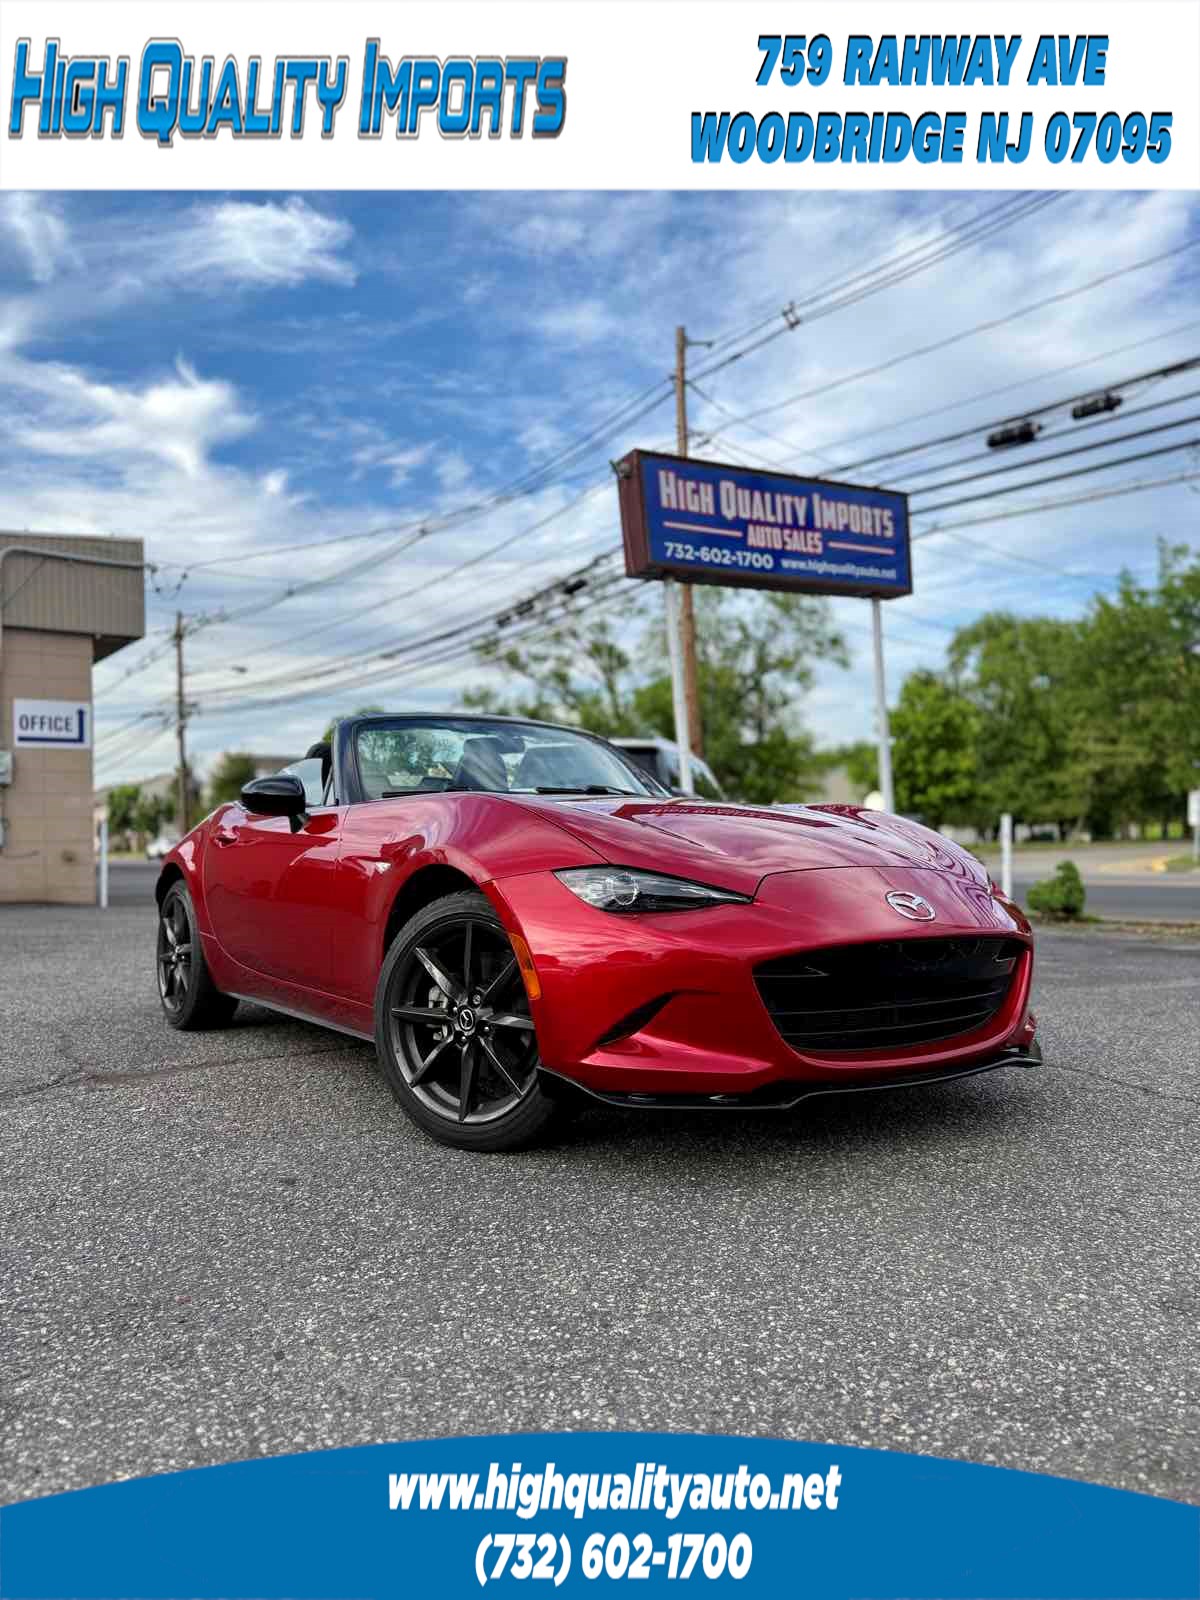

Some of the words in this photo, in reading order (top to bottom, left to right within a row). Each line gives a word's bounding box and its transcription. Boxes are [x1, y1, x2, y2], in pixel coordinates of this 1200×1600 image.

[747, 524, 782, 549] AUTO
[783, 528, 823, 555] SALES
[664, 541, 774, 570] 732-602-1700
[18, 713, 73, 732] OFFICE
